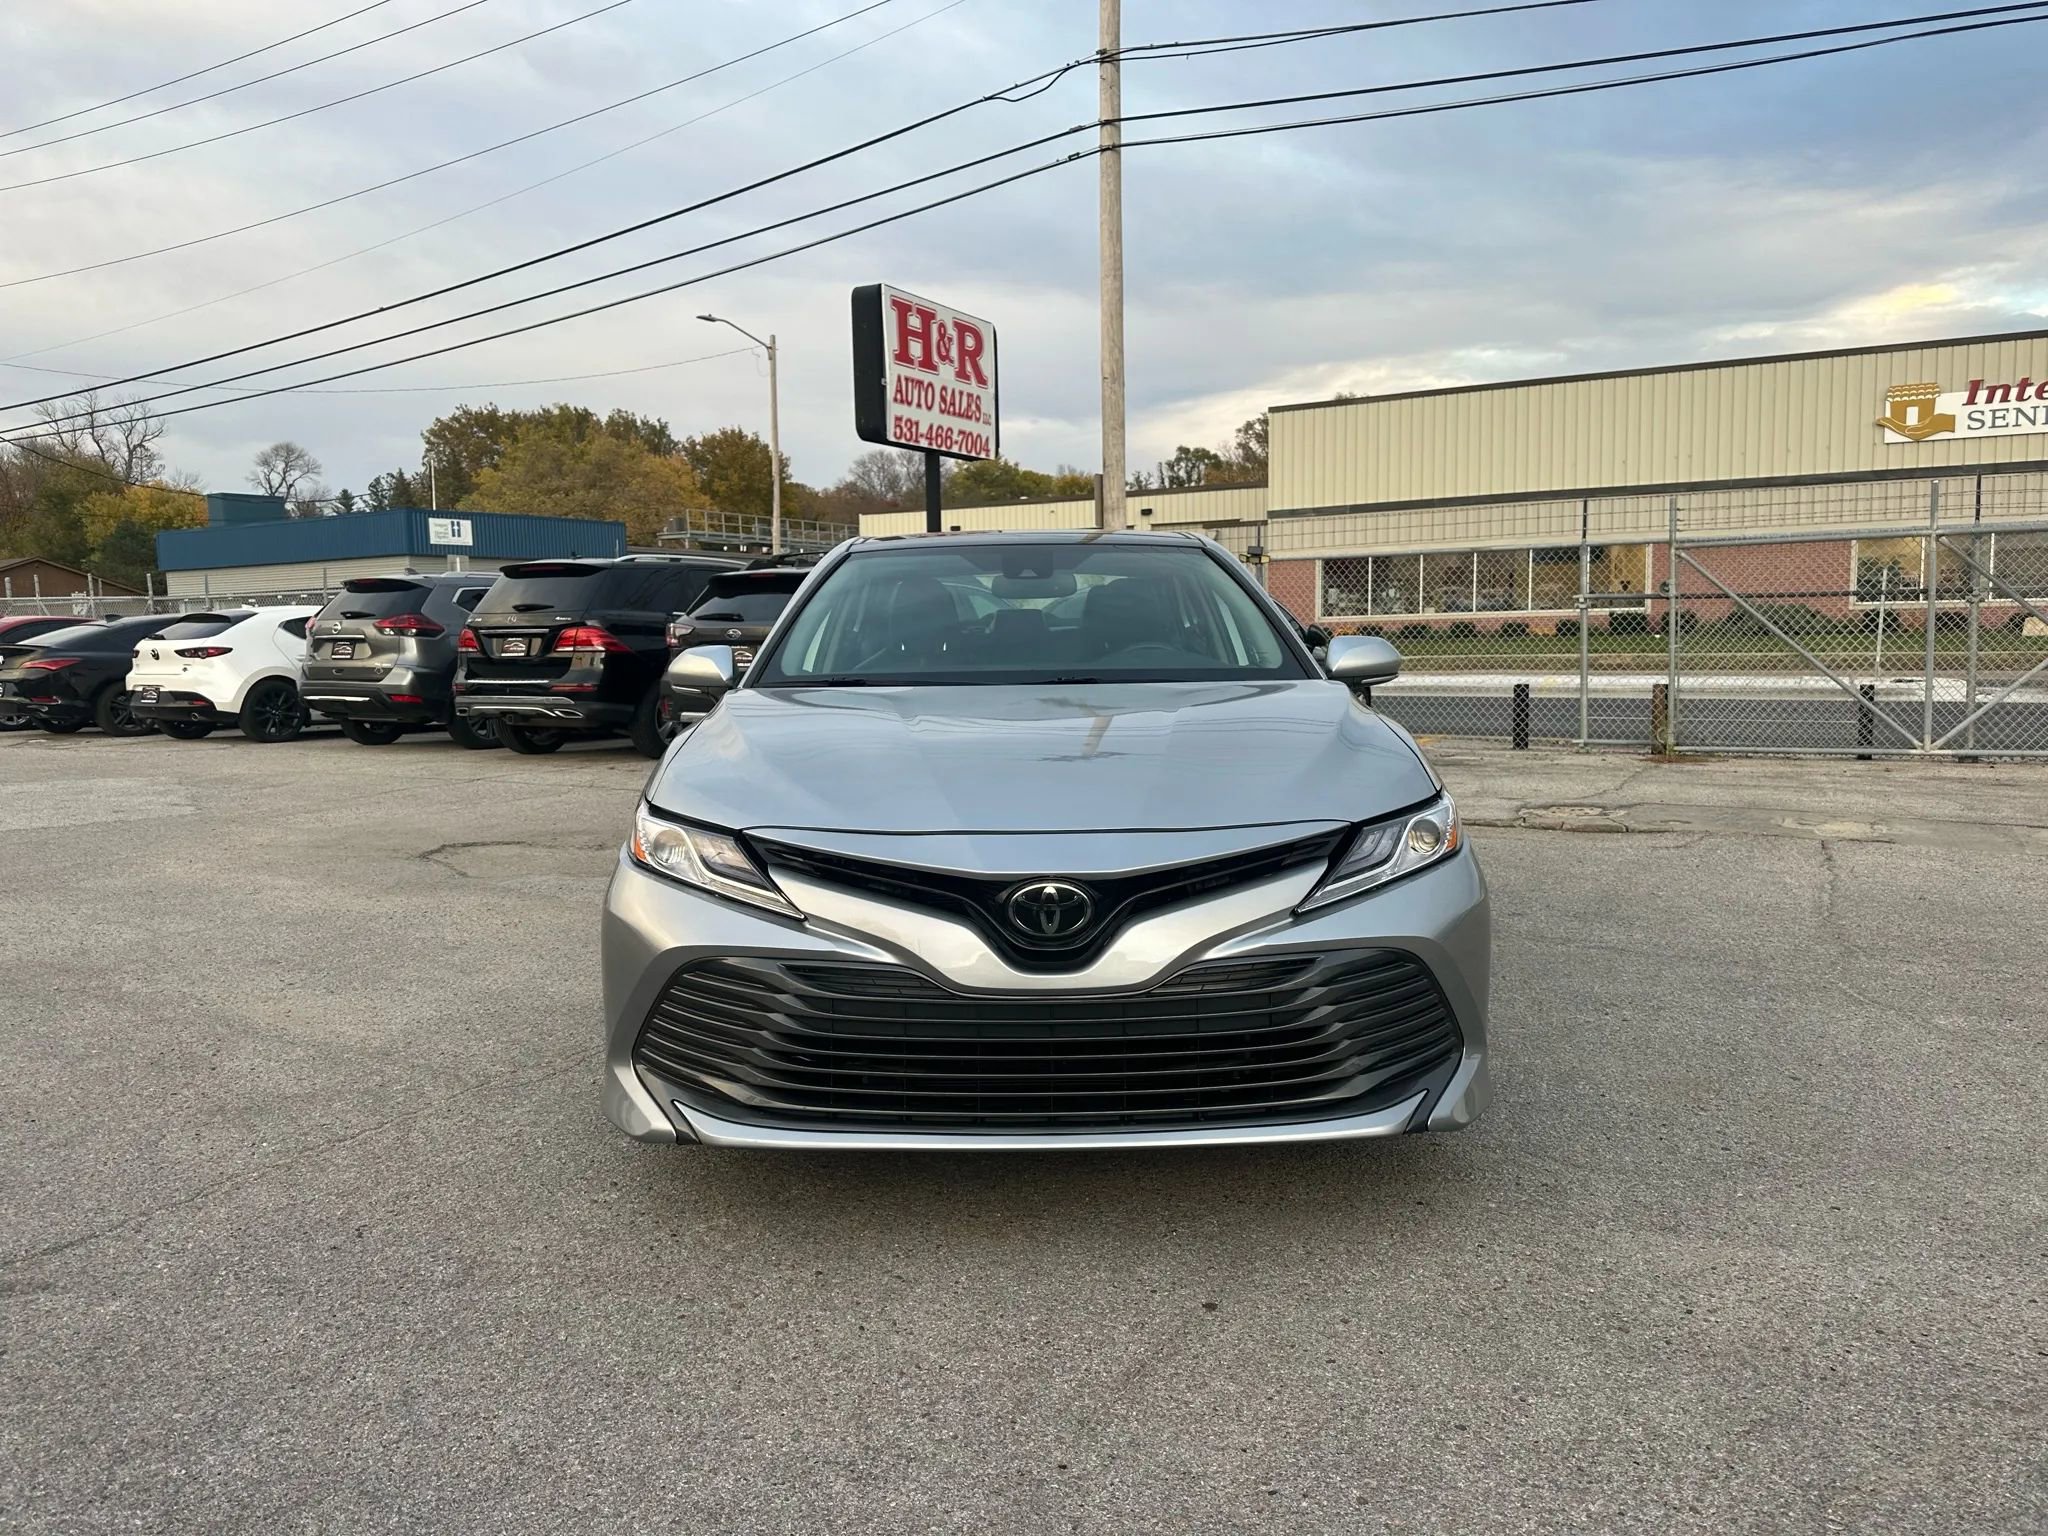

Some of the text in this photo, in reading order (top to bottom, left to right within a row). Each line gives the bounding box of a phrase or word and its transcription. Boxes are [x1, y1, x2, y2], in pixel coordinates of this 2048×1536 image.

[890, 294, 988, 389] H&R
[893, 374, 935, 411] AUTO
[938, 387, 982, 424] SALES
[1962, 377, 2048, 406] Inte
[893, 415, 991, 458] 531-466-7004
